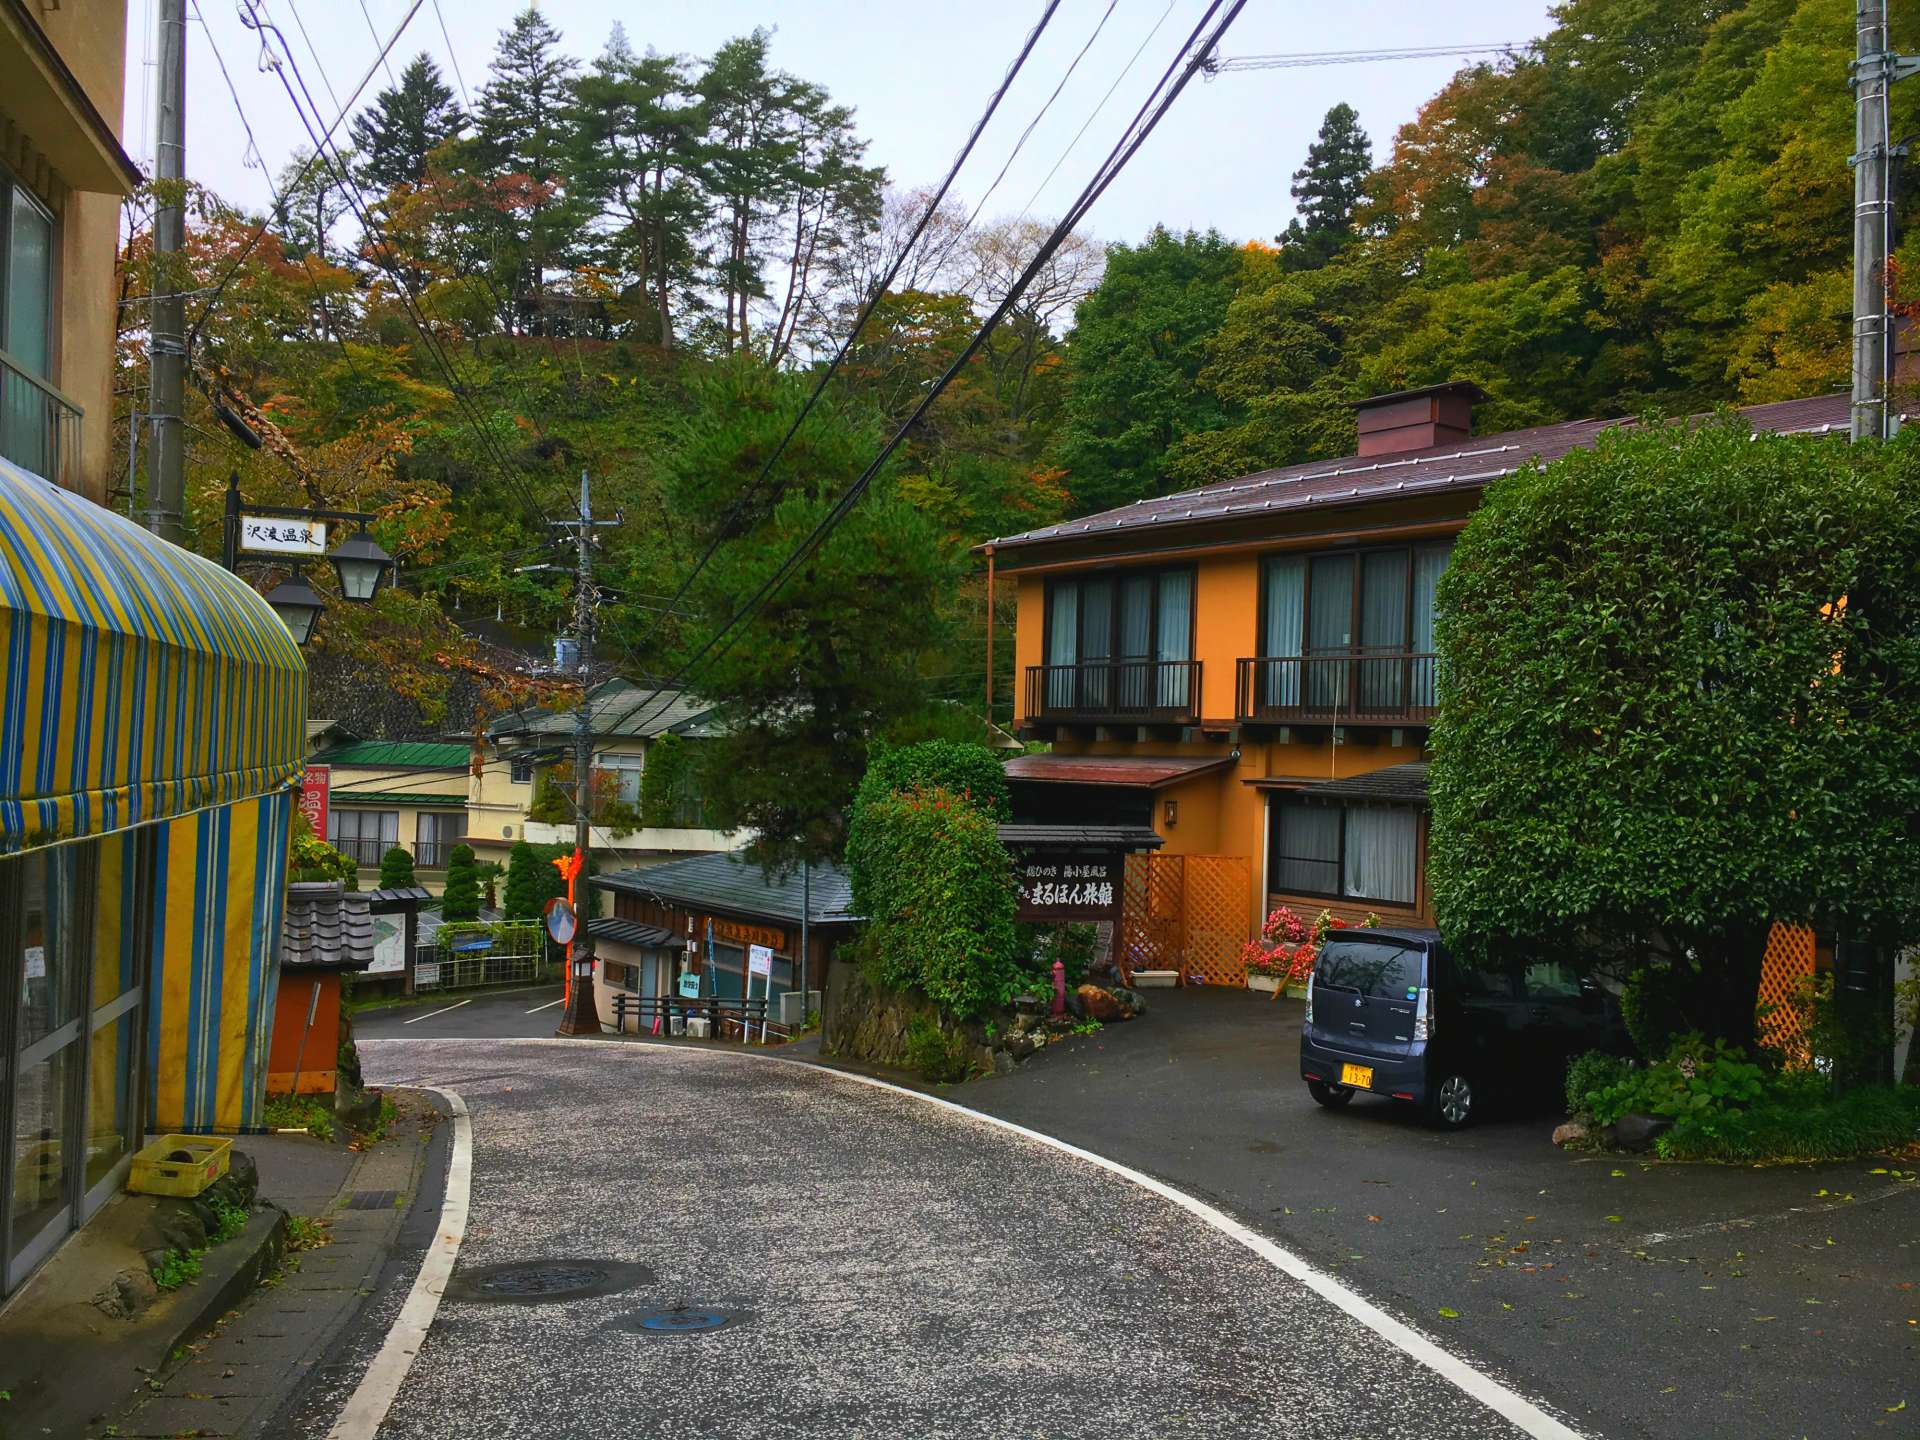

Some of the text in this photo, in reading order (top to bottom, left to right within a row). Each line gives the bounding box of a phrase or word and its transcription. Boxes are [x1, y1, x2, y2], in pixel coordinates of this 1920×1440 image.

[246, 524, 321, 546] 沢渡温泉
[1031, 882, 1113, 906] まるほん旅館
